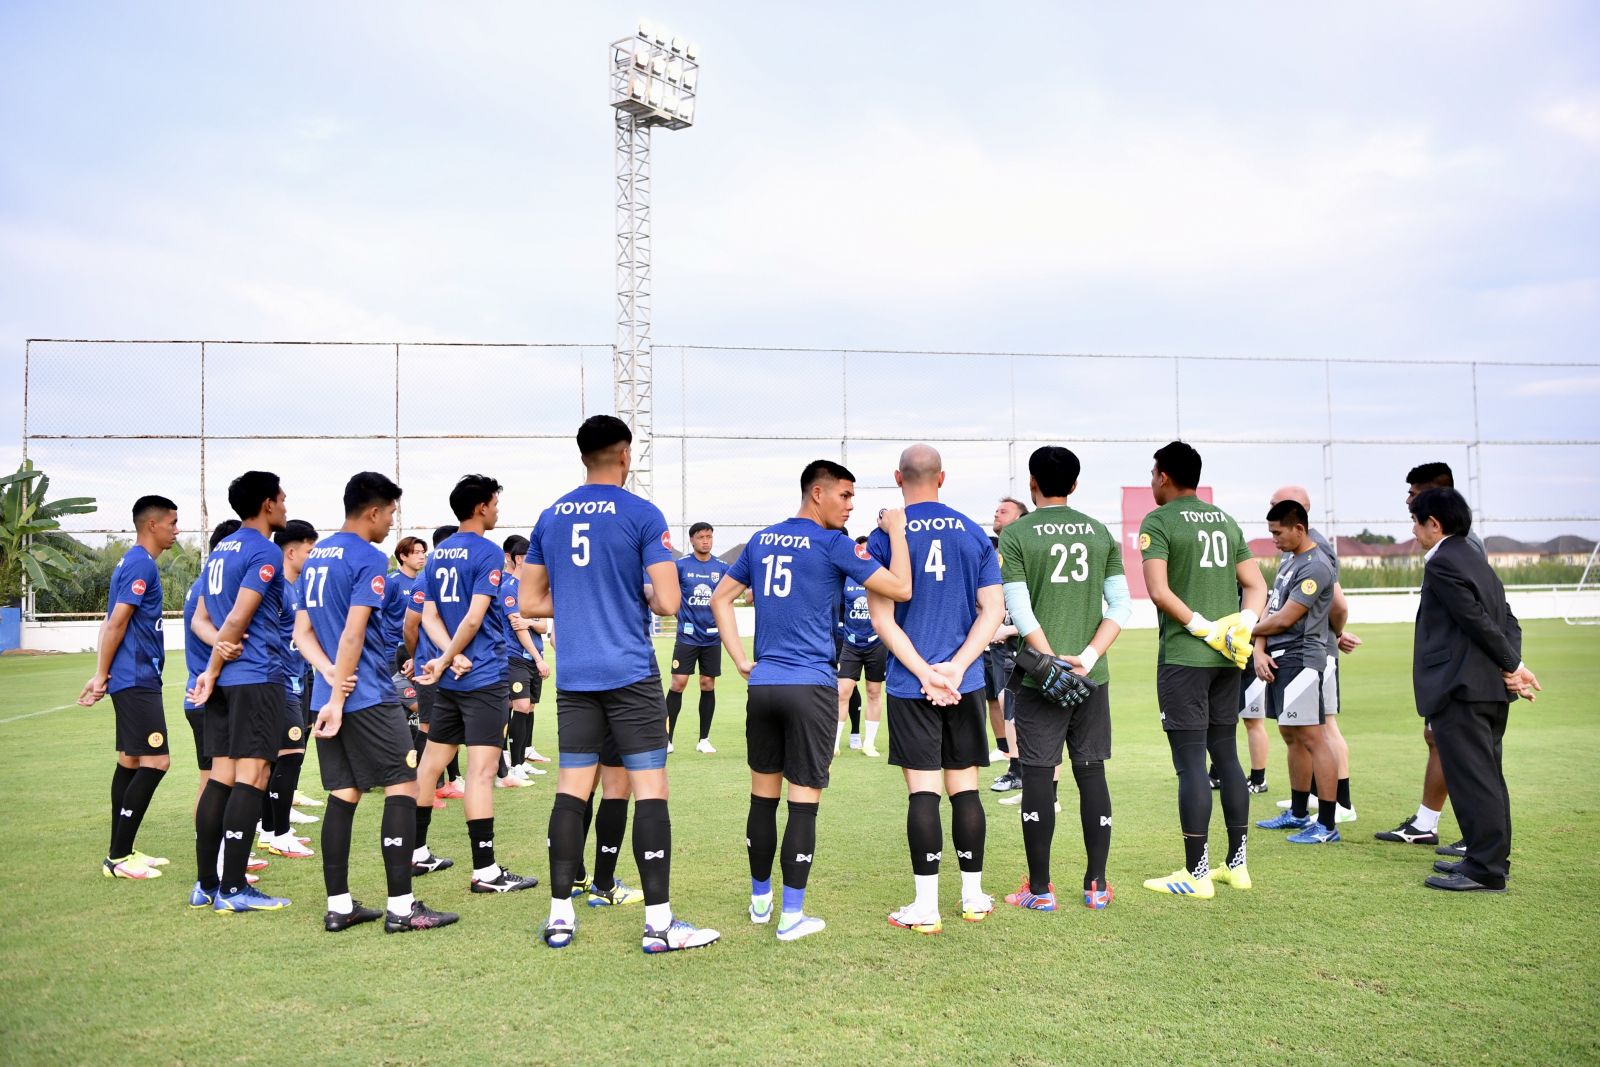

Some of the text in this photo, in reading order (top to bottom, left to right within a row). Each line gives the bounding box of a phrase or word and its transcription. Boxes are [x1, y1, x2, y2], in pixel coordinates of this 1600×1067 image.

[554, 501, 617, 515] TOYOTA
[907, 517, 966, 532] OYOTA
[1180, 510, 1228, 523] TOYOTA
[571, 523, 590, 567] 5
[759, 533, 811, 549] TOYOTA
[1033, 523, 1096, 536] TOYOTA
[924, 539, 946, 581] 4
[1050, 542, 1089, 583] 23
[1198, 529, 1228, 568] 20
[208, 558, 224, 595] 10
[305, 566, 329, 608] 27
[436, 566, 460, 603] 22
[762, 554, 793, 598] 15
